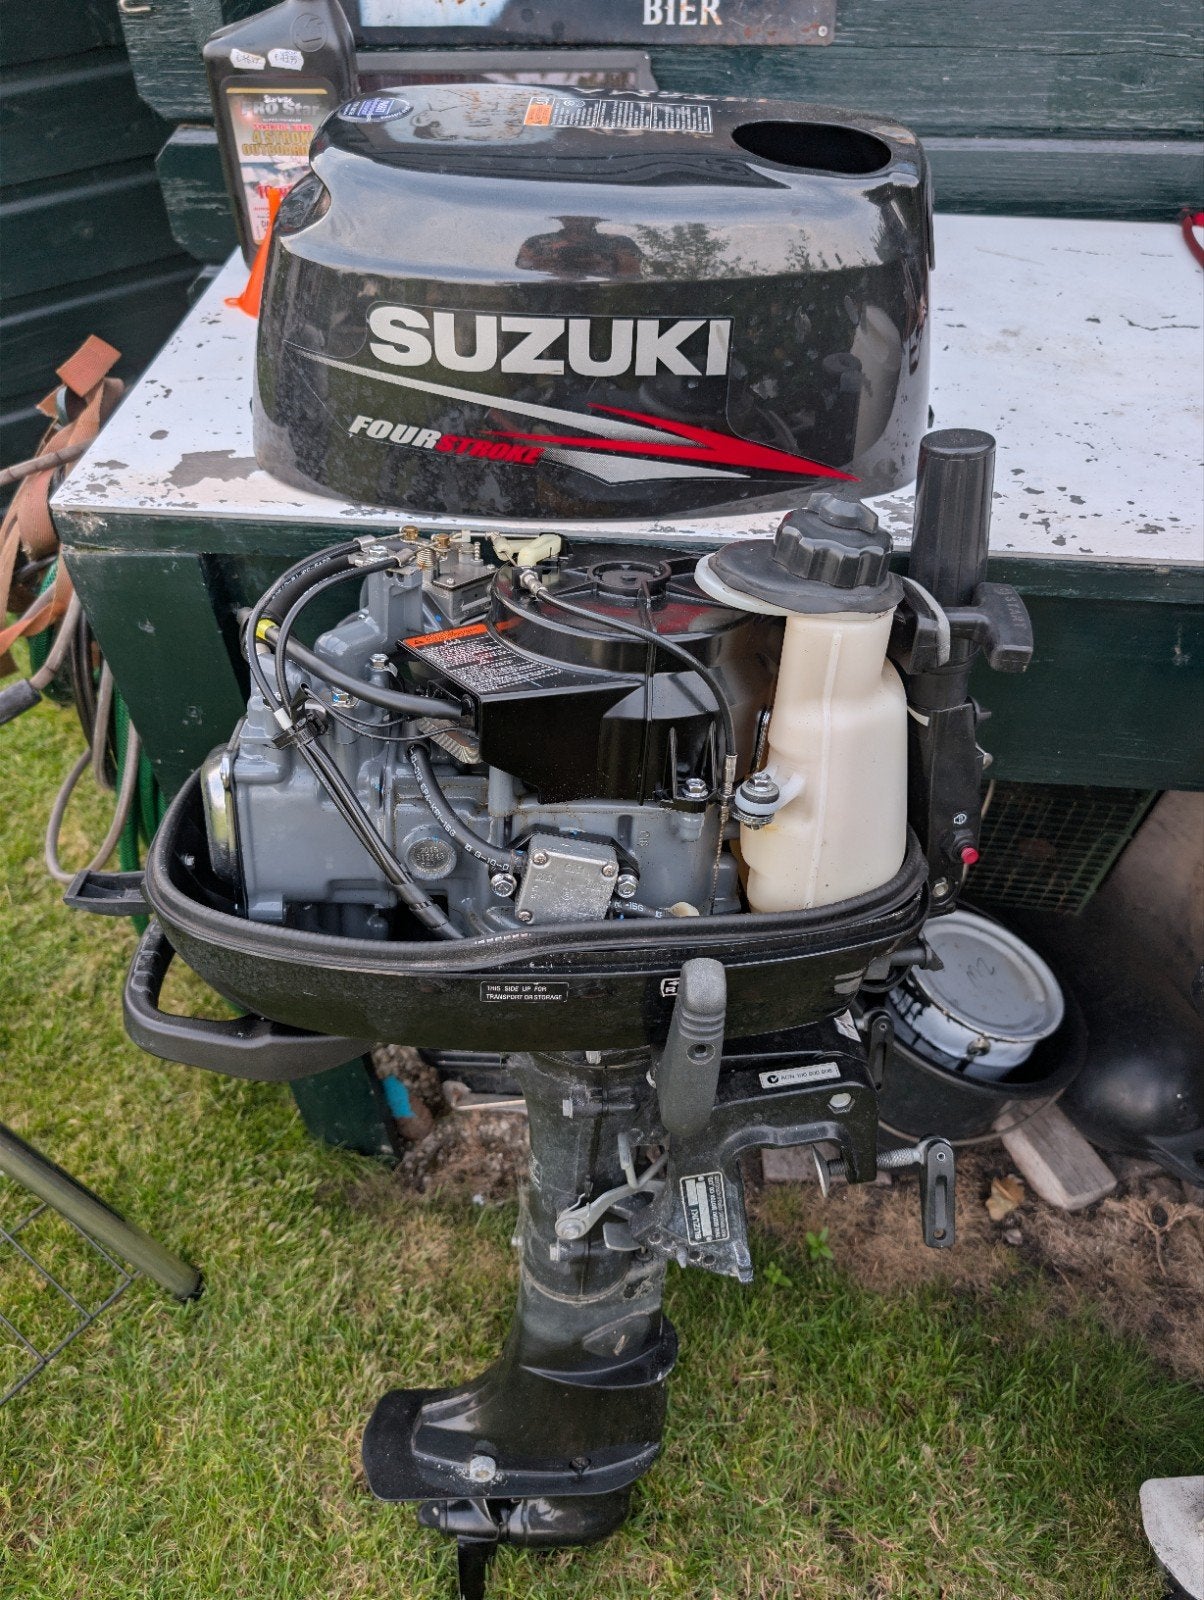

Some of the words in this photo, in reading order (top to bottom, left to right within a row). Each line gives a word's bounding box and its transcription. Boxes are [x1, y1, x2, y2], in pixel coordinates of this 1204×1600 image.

[642, 0, 723, 26] BIER
[369, 306, 732, 377] SUZUKI
[691, 1208, 702, 1240] SUZUKI
